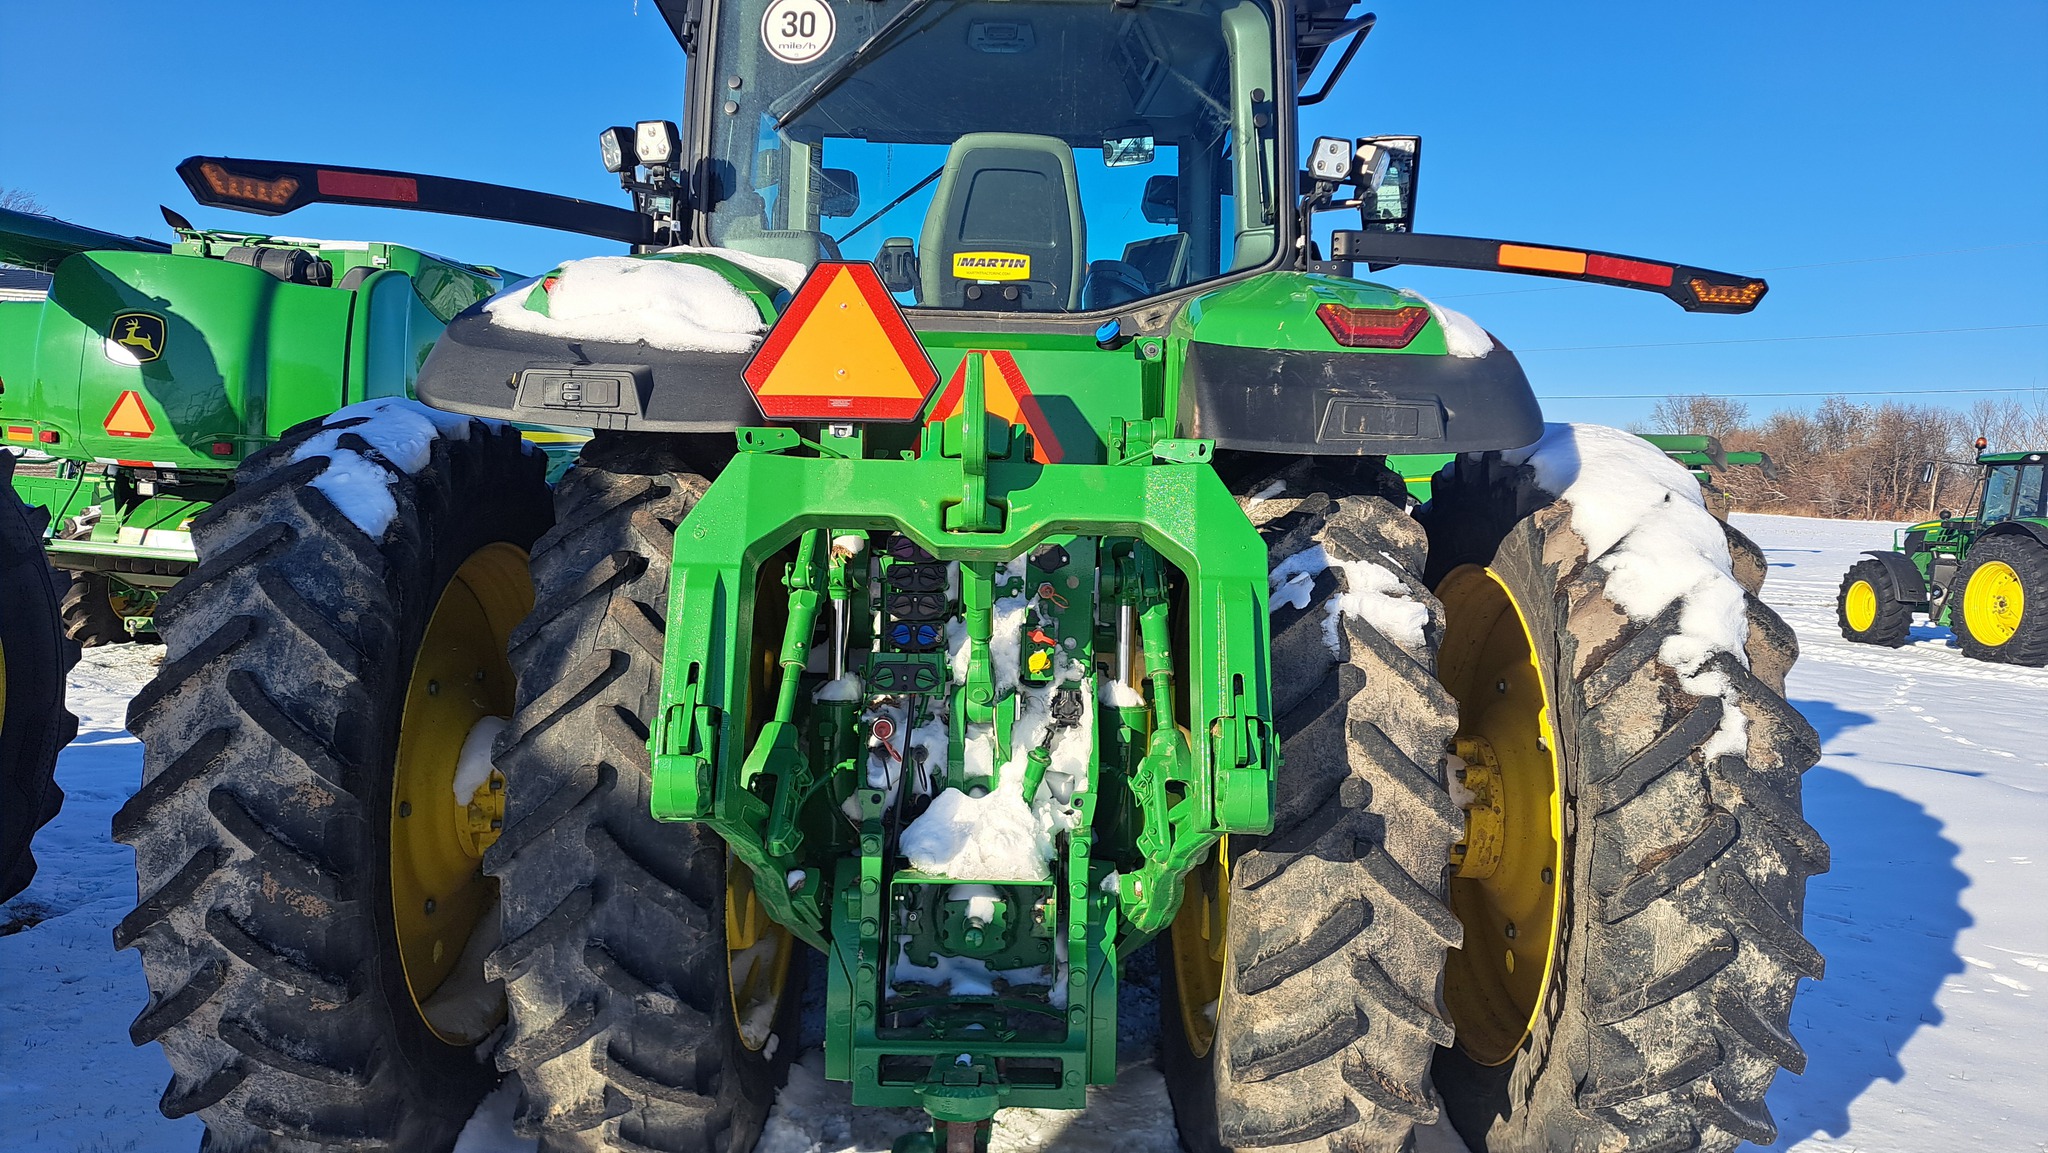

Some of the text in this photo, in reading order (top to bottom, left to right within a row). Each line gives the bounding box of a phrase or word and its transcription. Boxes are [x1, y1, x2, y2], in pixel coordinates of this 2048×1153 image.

[781, 10, 816, 38] 30
[778, 41, 817, 50] mile/h
[959, 257, 1027, 269] MARTIN
